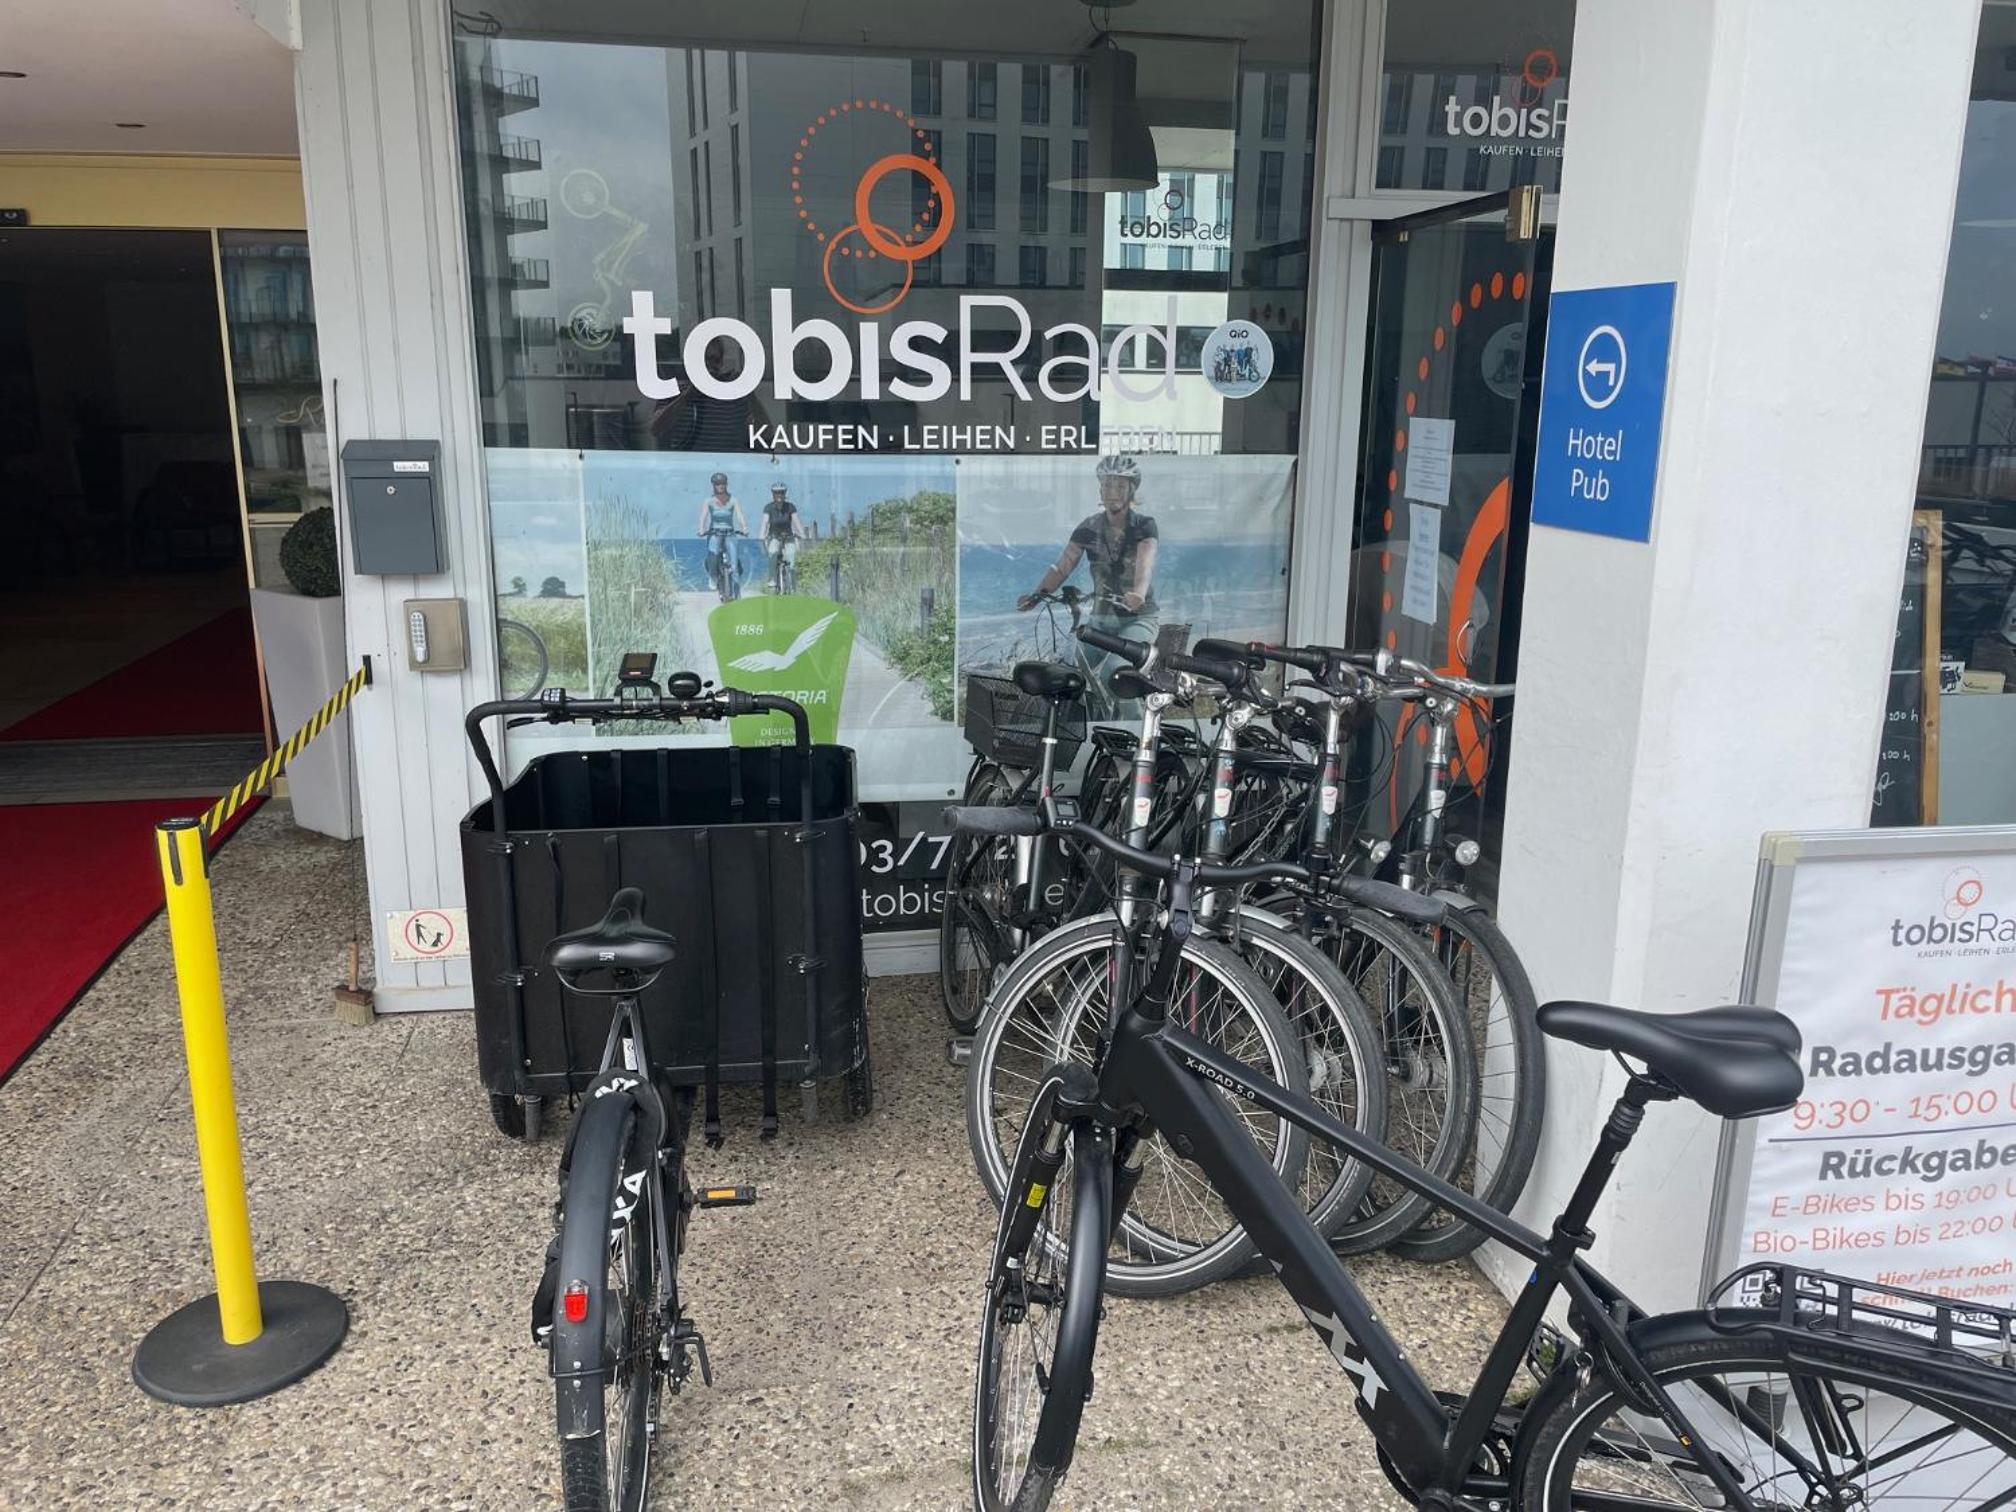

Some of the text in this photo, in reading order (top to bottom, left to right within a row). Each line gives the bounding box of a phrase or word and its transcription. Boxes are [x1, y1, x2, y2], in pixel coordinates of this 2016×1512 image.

[1479, 145, 1565, 158] KAUFEN LEIHE
[623, 288, 1177, 401] tobisRad
[748, 424, 879, 449] KAUFEN
[903, 424, 1016, 450] LEIHEN
[1568, 428, 1623, 461] Hotel
[1571, 468, 1610, 501] Pub
[735, 624, 764, 635] 1886
[1890, 912, 2016, 947] tobisRa
[1918, 949, 1952, 959] KAUFEN
[1958, 947, 1990, 957] LEIHEN
[1875, 979, 2016, 1027] Täglich
[1809, 1041, 2016, 1078] Radausga
[1185, 1057, 1256, 1101] X-ROAD 5.0
[1794, 1099, 1871, 1131] 9:30
[1907, 1089, 1999, 1123] 15:00
[1818, 1138, 2016, 1183] Rückgabe
[1771, 1193, 1876, 1218] E-Bikes
[1885, 1187, 1925, 1212] bis
[1933, 1183, 1998, 1210] 19:00
[1753, 1226, 1885, 1254] Bio-Bikes
[1895, 1223, 1931, 1246] bis
[1937, 1214, 2004, 1241] 22:00
[1875, 1258, 2013, 1286] Hier jetzt noch
